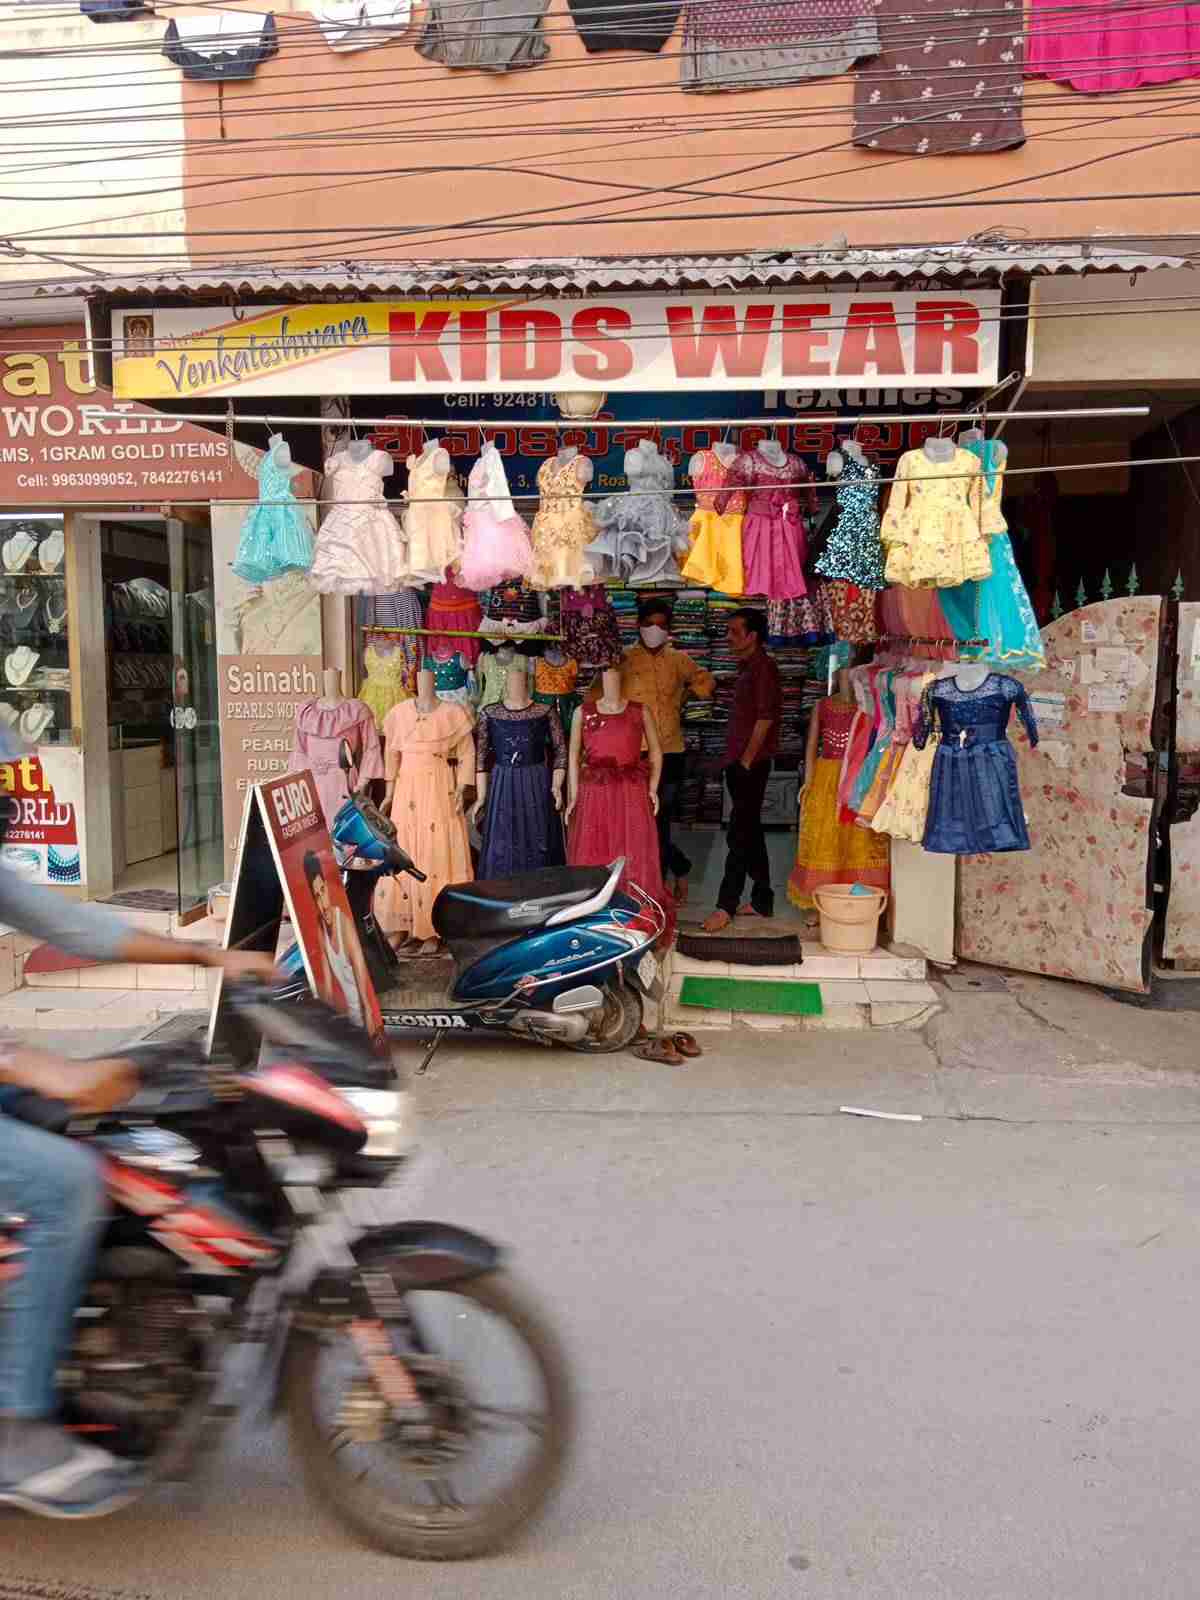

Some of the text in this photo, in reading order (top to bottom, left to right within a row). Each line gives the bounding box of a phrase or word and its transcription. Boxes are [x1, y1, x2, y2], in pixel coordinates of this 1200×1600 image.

[388, 301, 981, 381] KIDS WEAR
[156, 315, 369, 391] Venkateshwara
[41, 445, 105, 463] 1GRAM
[111, 443, 165, 460] GOLD
[170, 442, 229, 458] ITEMS
[17, 471, 223, 487] Cell: 9963099052, 7842276141
[227, 663, 317, 694] Sainath
[226, 701, 274, 719] PEARLS
[247, 759, 289, 771] RUBY
[272, 780, 313, 827] EURO
[382, 1015, 467, 1028] HONDA
